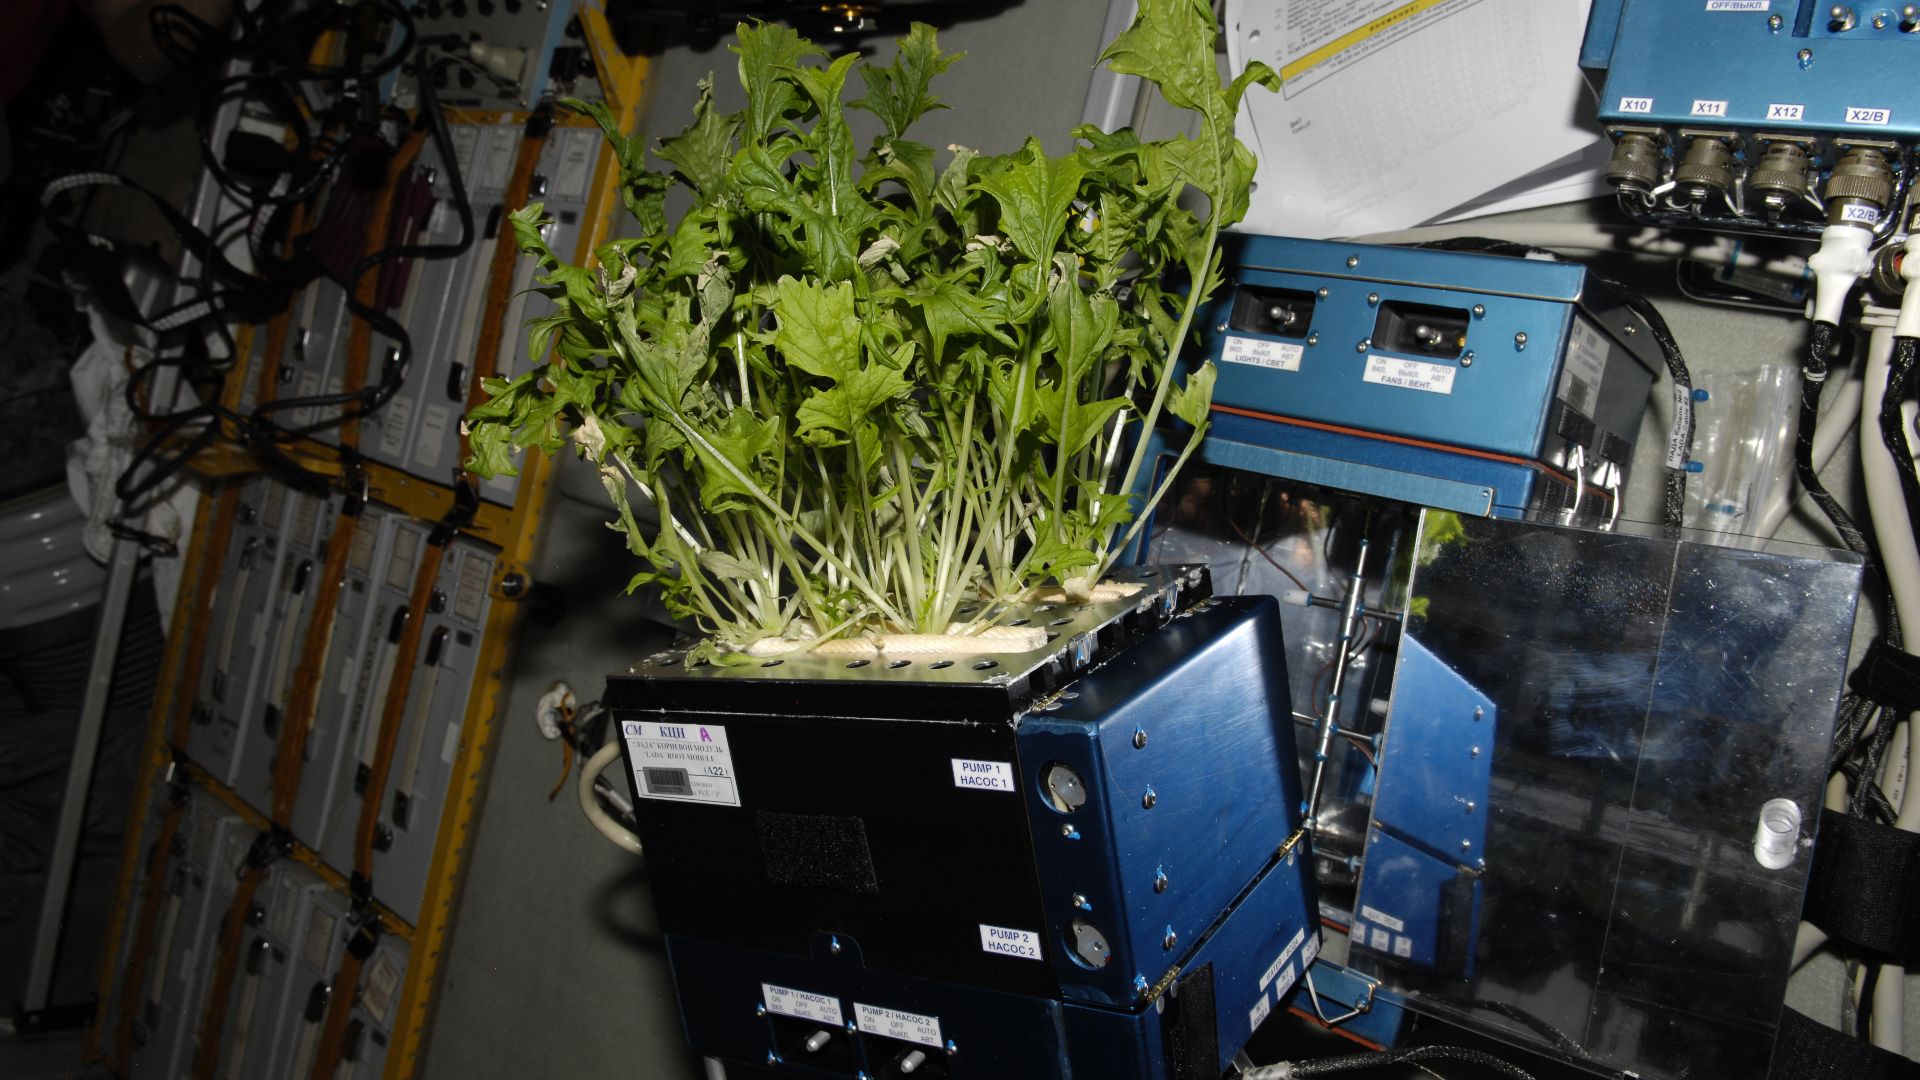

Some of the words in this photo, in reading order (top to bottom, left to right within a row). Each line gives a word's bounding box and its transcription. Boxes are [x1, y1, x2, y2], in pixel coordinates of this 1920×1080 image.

[1624, 100, 1648, 110] X10
[1697, 103, 1720, 113] X11
[1773, 107, 1798, 117] X12
[1851, 111, 1884, 122] X2/B
[1846, 207, 1875, 221] X2/B
[1235, 355, 1260, 364] LIGHTS
[1381, 376, 1402, 385] FANS
[962, 762, 992, 774] PUMP
[996, 765, 1001, 774] 1
[960, 776, 999, 788] НАСОС
[1002, 779, 1007, 788] 1
[990, 929, 1020, 941] PUMP
[1022, 934, 1029, 943] 2
[988, 941, 1026, 955] НАСОС
[1029, 947, 1035, 956] 2
[770, 986, 789, 996] PUMP
[771, 995, 782, 1003] ON
[820, 1006, 838, 1015] AUTO
[862, 1006, 884, 1016] PUMP
[895, 1013, 924, 1025] НАСОС
[864, 1016, 875, 1024] ON
[891, 1021, 904, 1029] OFF
[917, 1026, 937, 1036] AUTO
